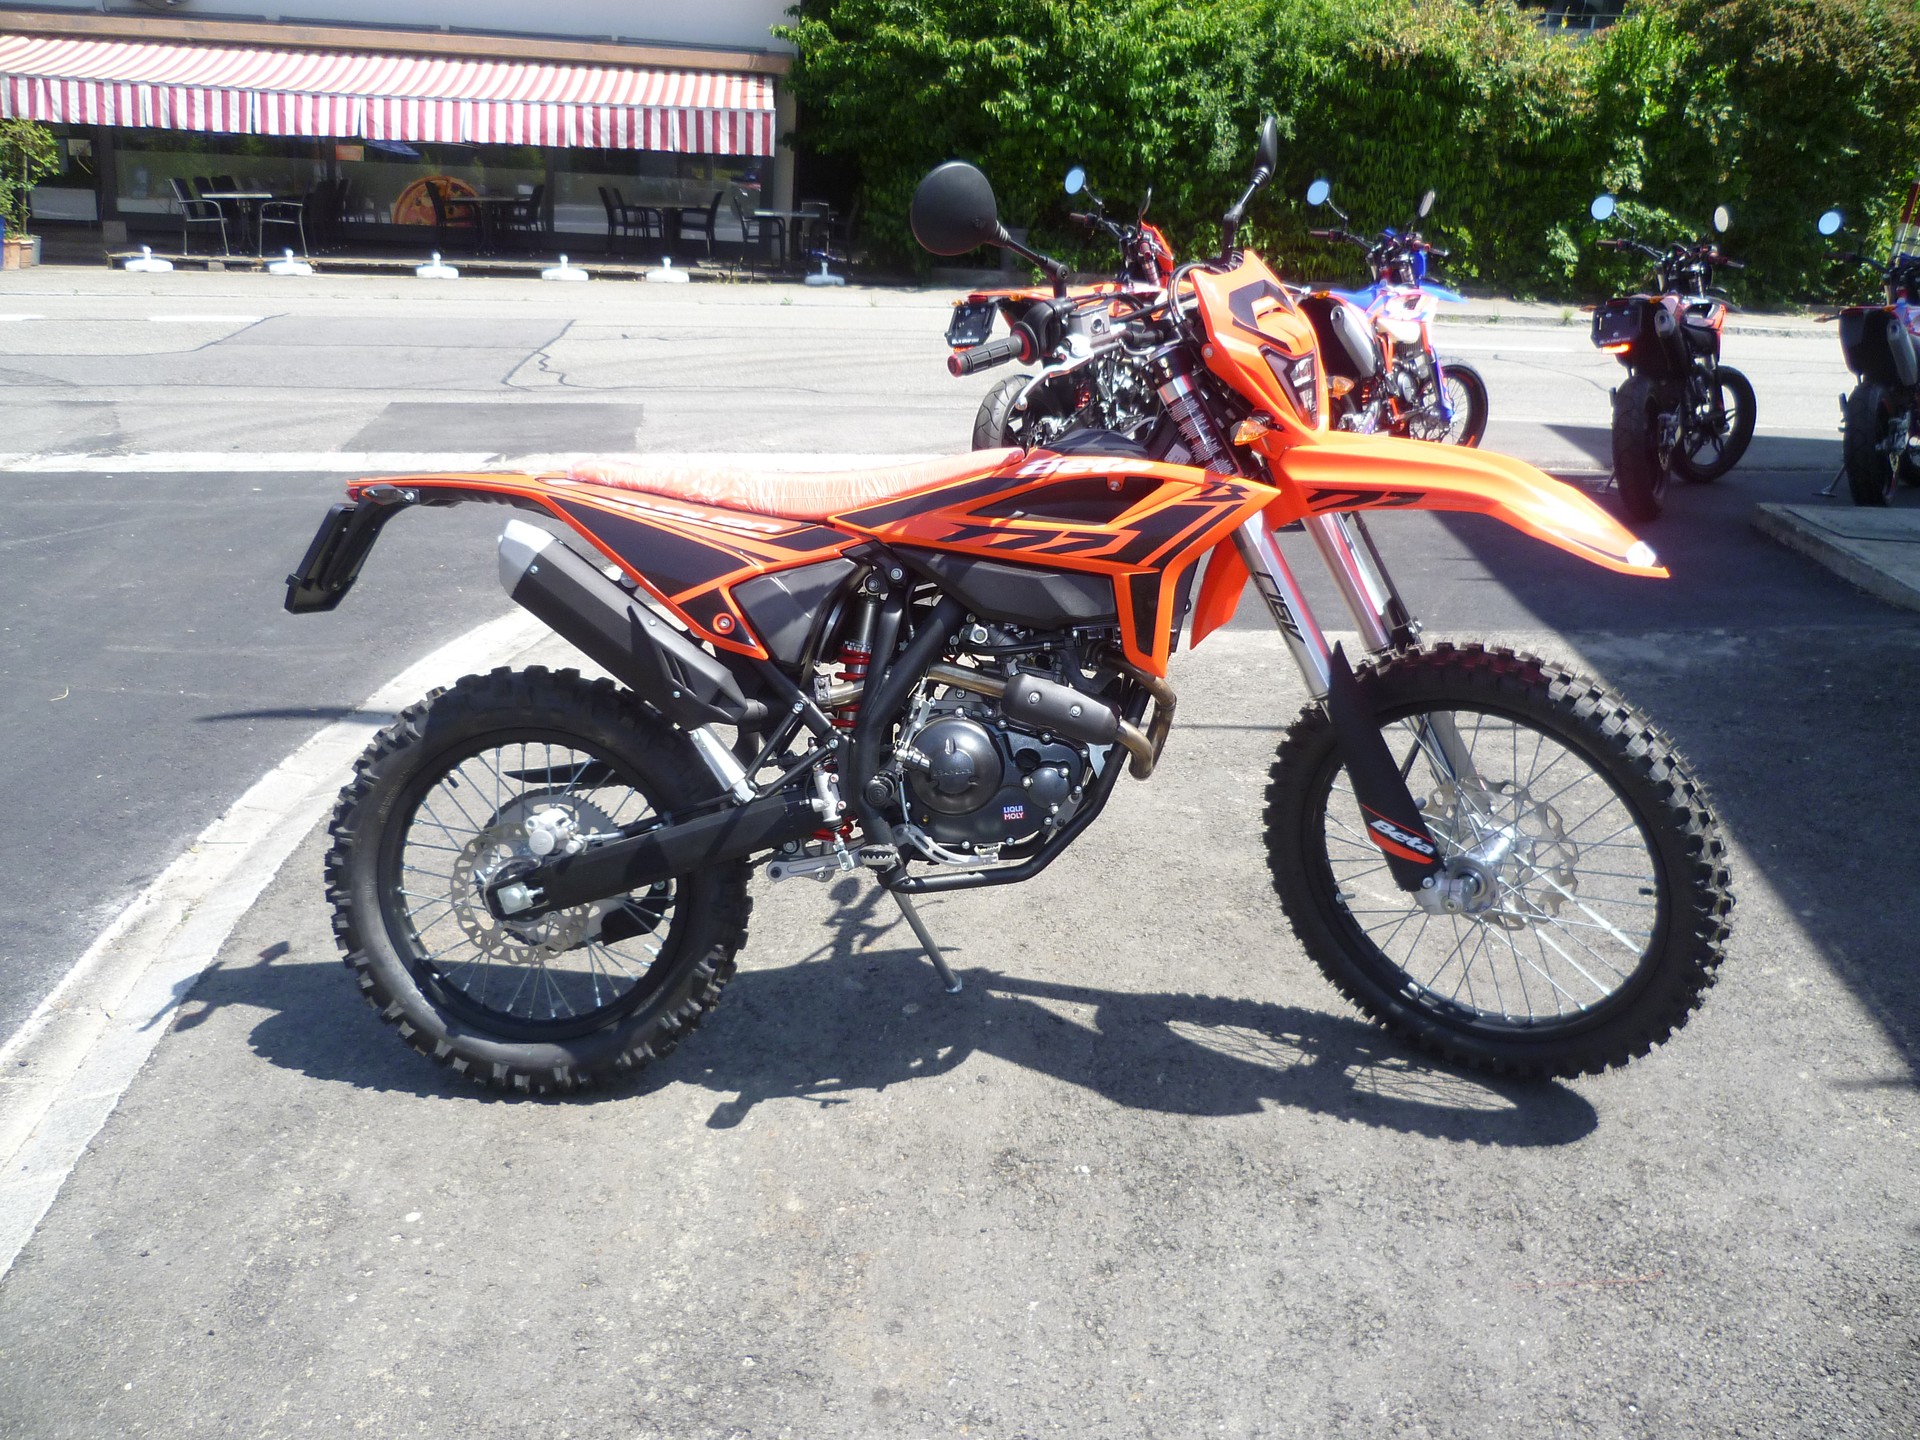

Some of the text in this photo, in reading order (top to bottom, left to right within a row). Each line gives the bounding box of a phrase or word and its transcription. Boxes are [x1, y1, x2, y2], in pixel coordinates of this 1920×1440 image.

[1003, 805, 1024, 813] LIQUI
[1004, 812, 1024, 820] MOLY
[1369, 819, 1435, 855] Beta
